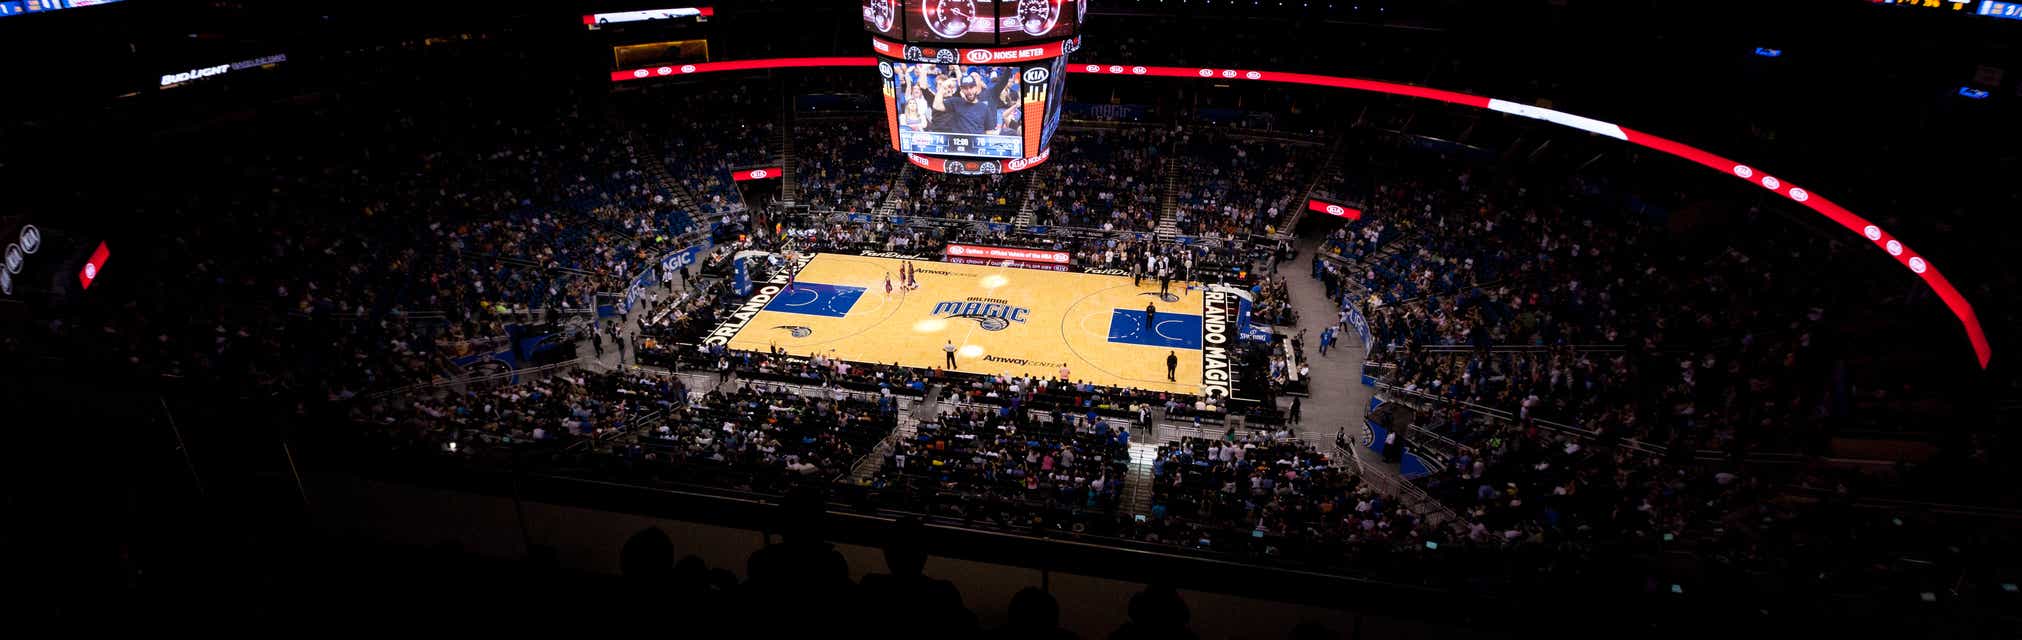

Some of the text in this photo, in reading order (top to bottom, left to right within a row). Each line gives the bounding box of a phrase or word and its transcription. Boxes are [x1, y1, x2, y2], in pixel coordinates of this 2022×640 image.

[971, 48, 1044, 60] KIA NOISE METER
[190, 64, 231, 79] LIGHT
[1027, 71, 1045, 80] KIA
[860, 250, 921, 259] FanDuel
[1084, 267, 1130, 277] FanDu
[705, 286, 780, 346] ORLANDO
[931, 301, 1030, 325] MAGIC
[1205, 290, 1229, 397] RLANDO MAGIC
[983, 354, 1061, 369] Amway CENTER
